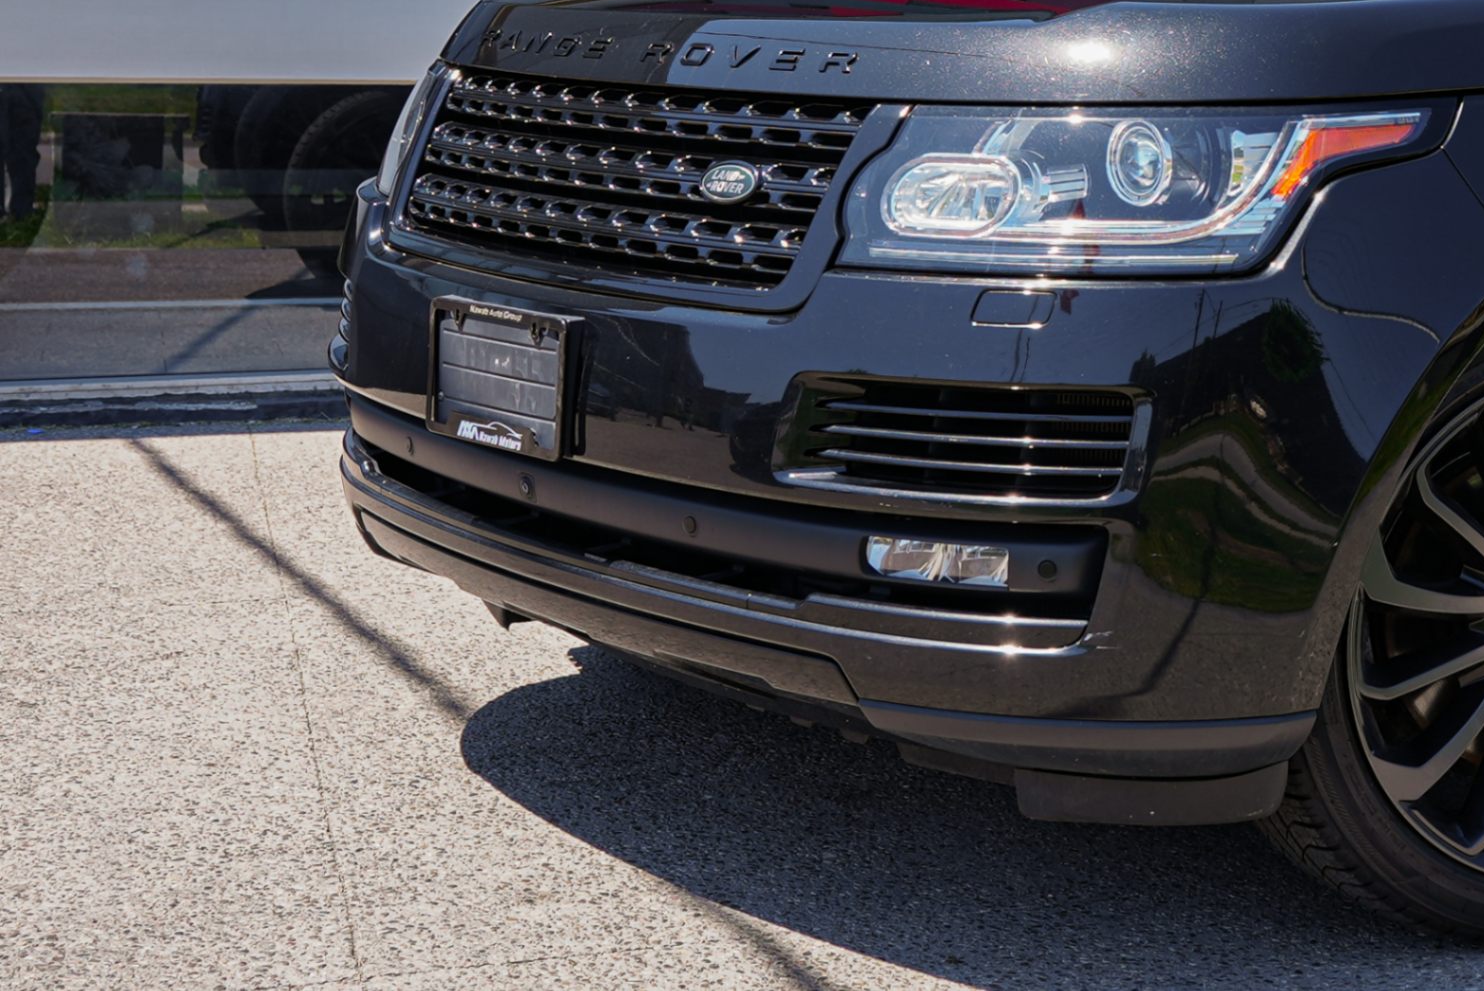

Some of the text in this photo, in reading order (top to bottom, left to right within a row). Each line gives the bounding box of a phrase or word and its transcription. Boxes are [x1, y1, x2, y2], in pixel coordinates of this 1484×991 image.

[480, 29, 859, 74] RANGE ROVER
[711, 170, 741, 181] LAND
[710, 180, 744, 194] ROVER
